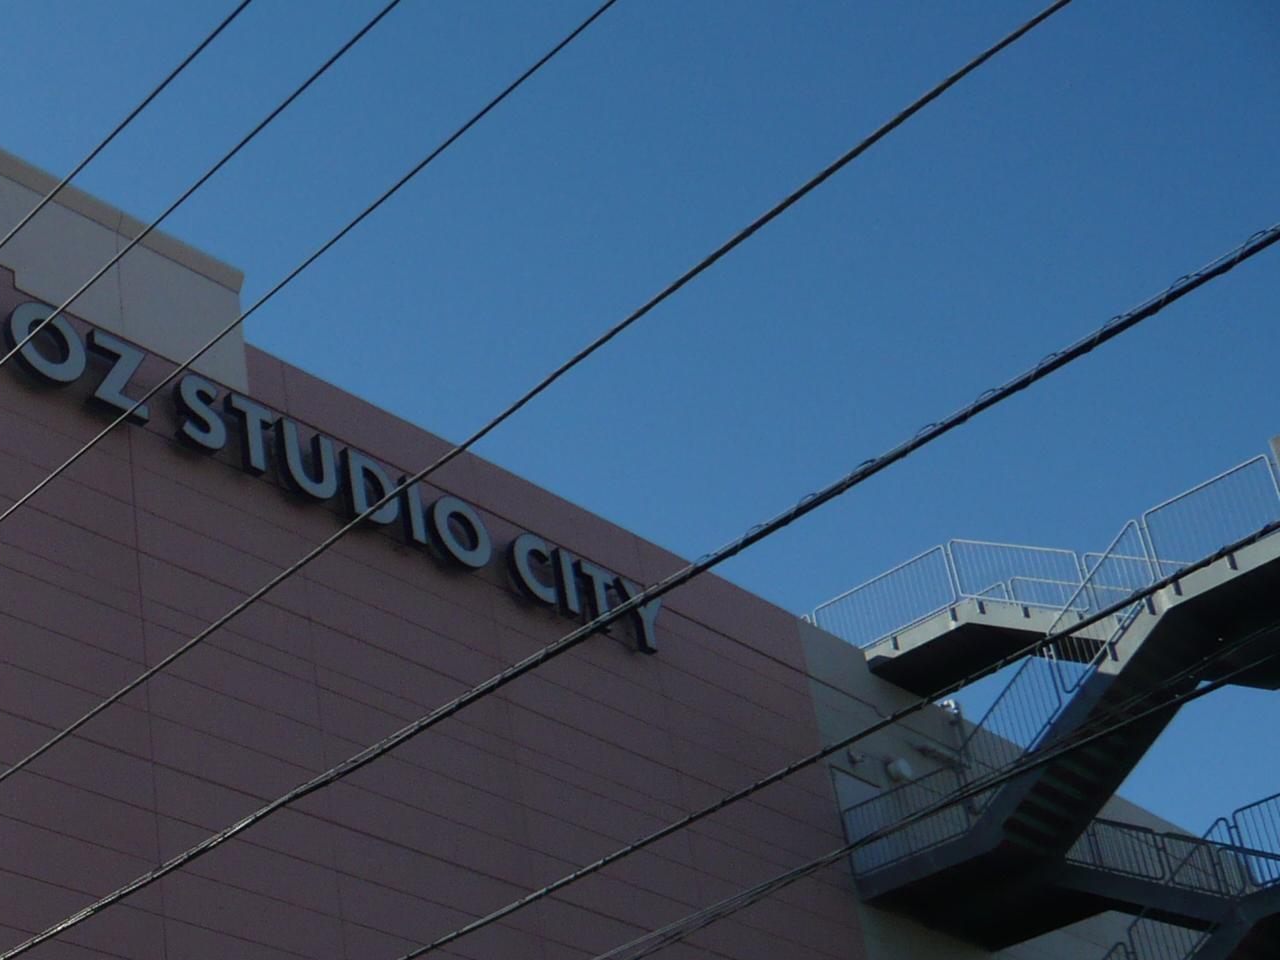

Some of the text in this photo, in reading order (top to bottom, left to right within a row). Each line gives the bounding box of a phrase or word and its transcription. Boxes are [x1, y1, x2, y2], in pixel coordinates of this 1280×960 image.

[6, 300, 661, 654] OZ STUDIO CITY
